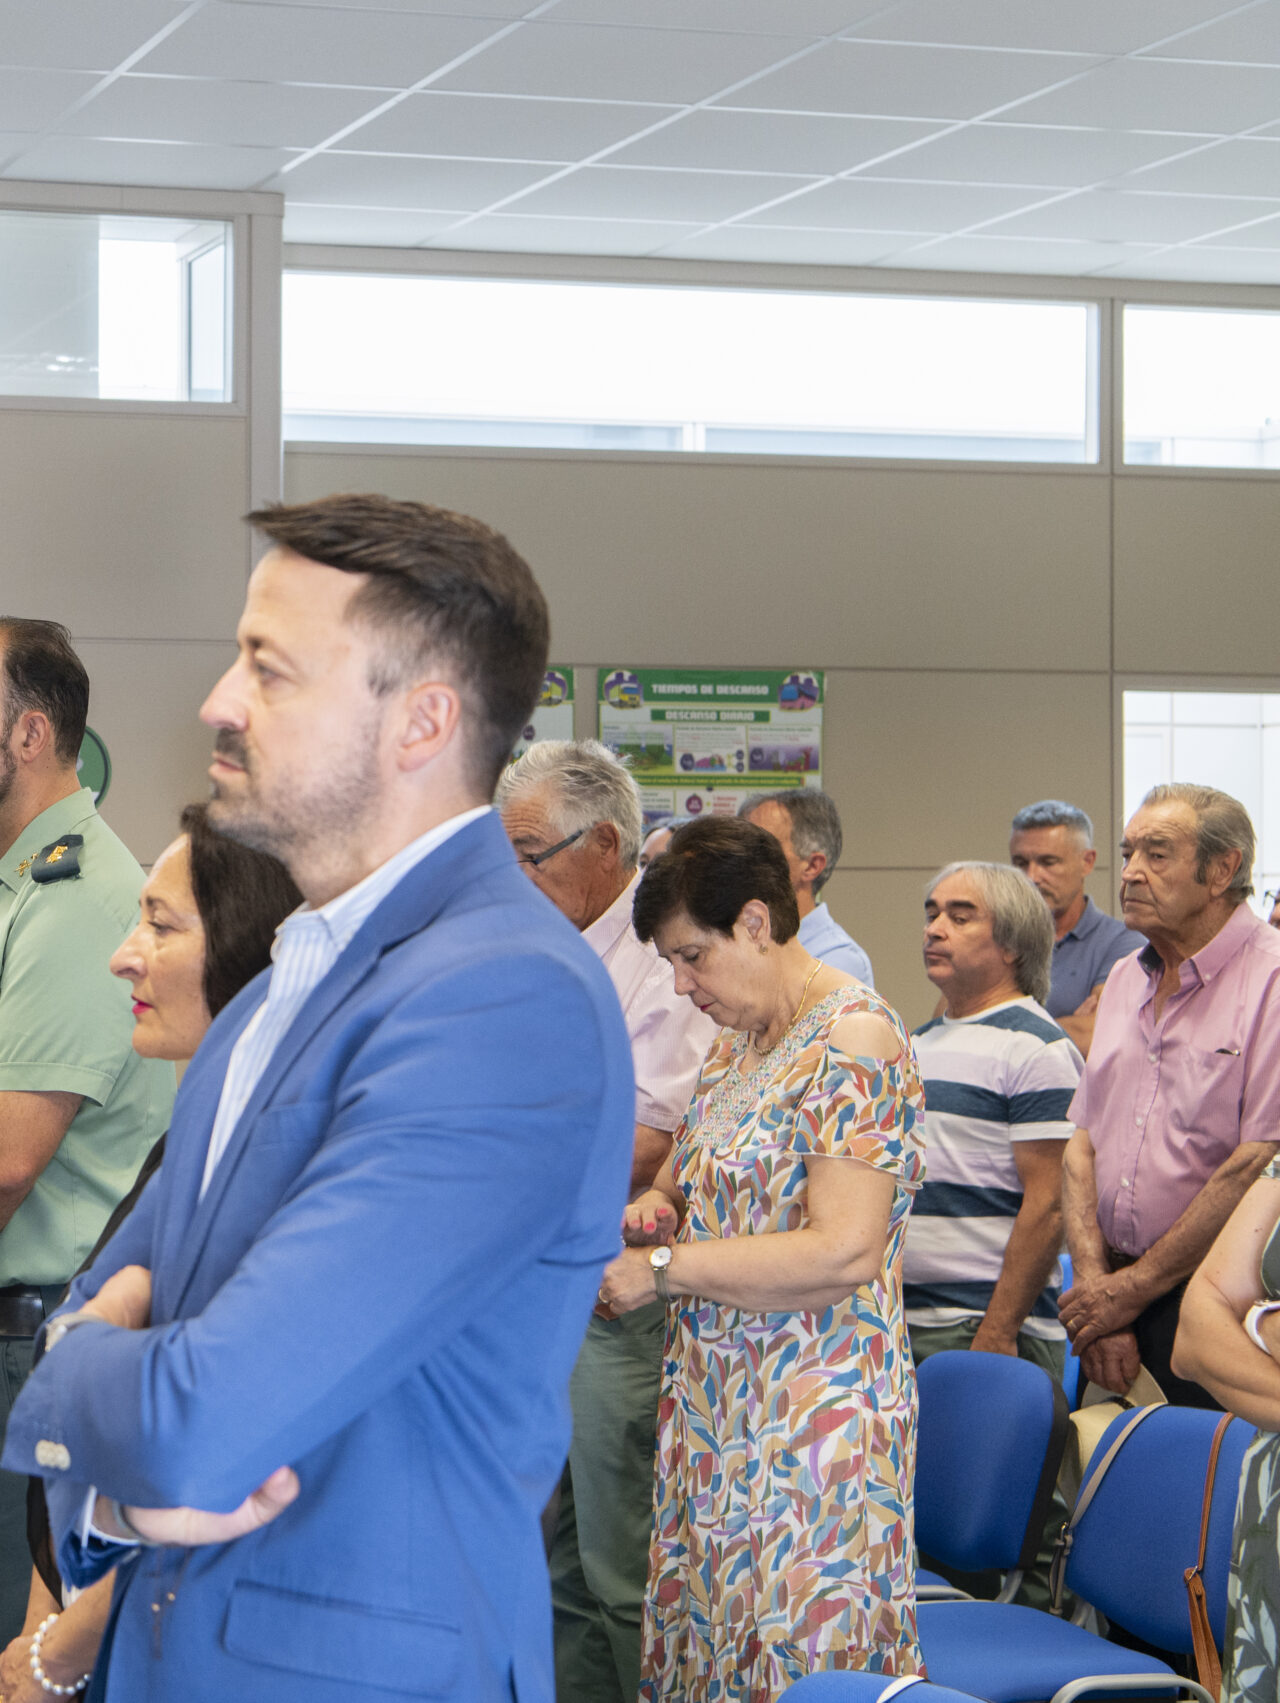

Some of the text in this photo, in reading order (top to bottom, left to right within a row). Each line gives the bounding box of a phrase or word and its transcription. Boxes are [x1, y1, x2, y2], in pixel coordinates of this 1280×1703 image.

[651, 684, 769, 695] TIEMPOS DE DESCANSO
[665, 711, 755, 721] DESCANSO DIARIO
